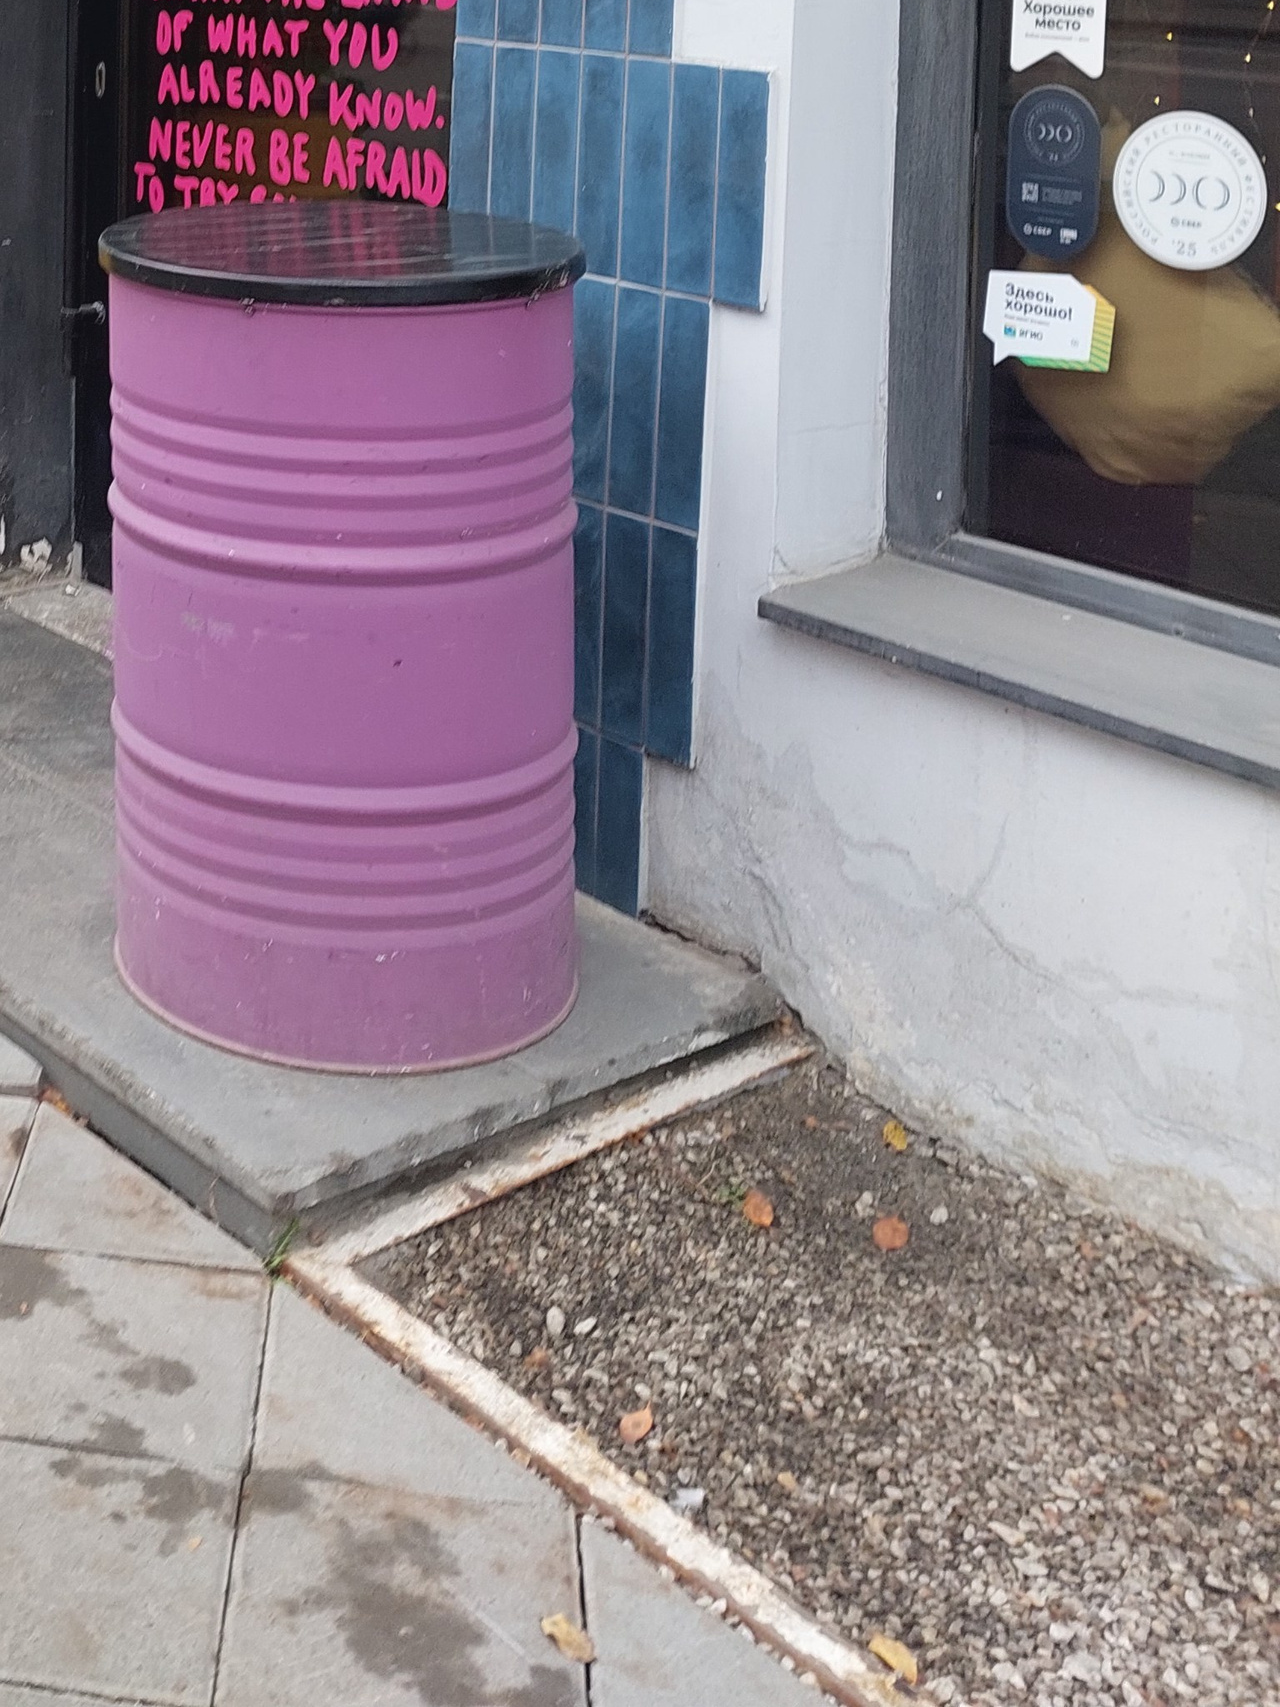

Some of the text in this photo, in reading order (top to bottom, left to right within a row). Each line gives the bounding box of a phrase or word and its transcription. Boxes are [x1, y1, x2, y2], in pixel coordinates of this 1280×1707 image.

[156, 9, 399, 72] OF WHAT YOU
[1034, 17, 1081, 31] место
[157, 59, 445, 131] ALREADY KNOW.
[148, 116, 447, 207] NEVER BE AFRAID
[134, 162, 165, 214] TO
[174, 174, 239, 210] TRY
[1004, 298, 1073, 322] хорошо!
[1005, 282, 1054, 304] Здесь
